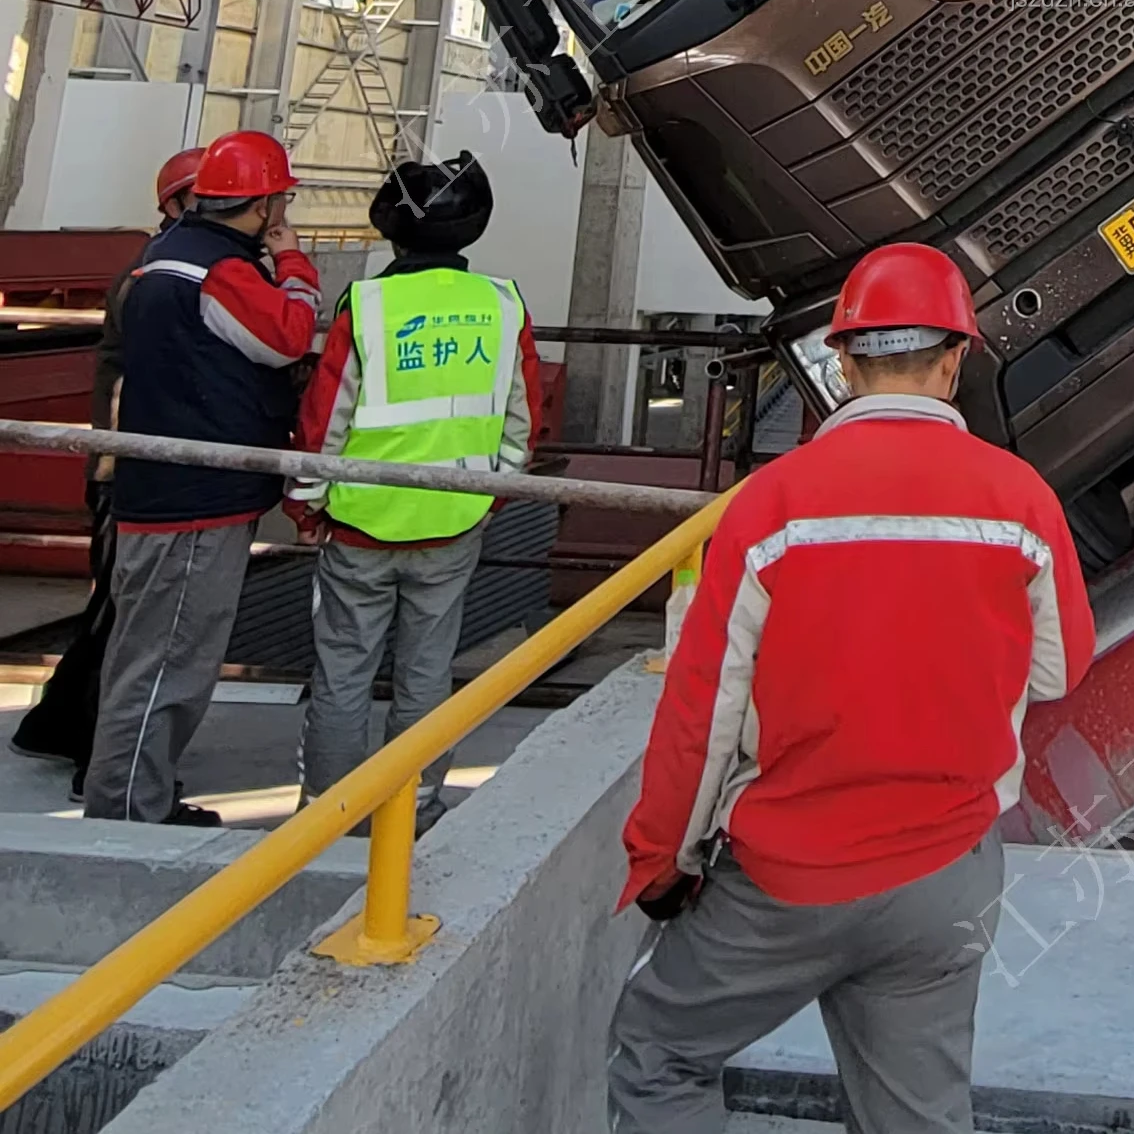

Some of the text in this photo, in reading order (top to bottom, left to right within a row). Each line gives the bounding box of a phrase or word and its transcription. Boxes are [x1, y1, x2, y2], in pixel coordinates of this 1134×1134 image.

[804, 1, 893, 75] 中国一汽
[396, 336, 491, 371] 监护人
